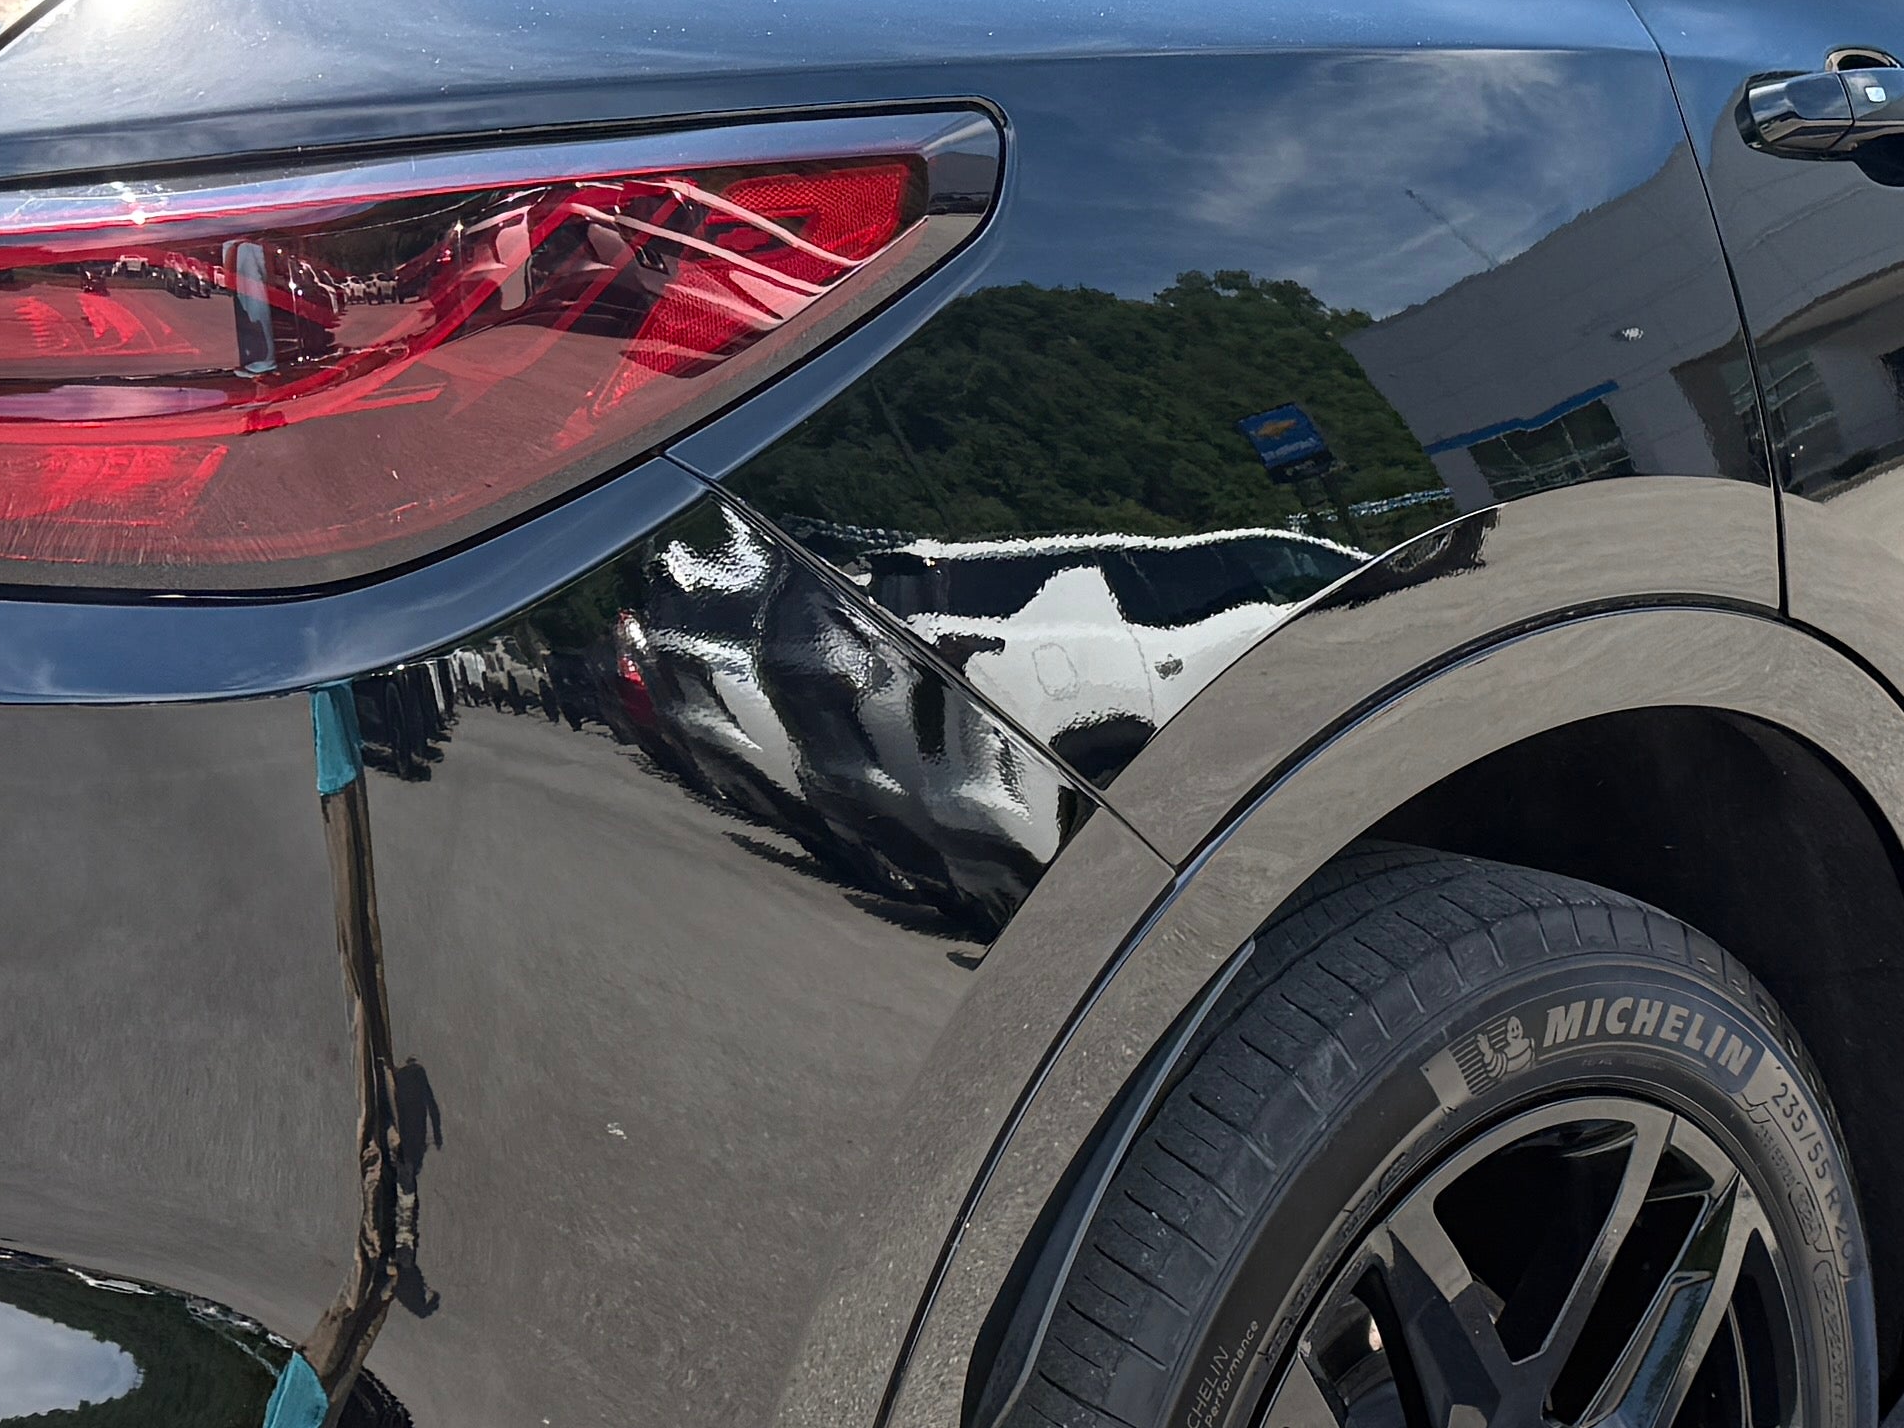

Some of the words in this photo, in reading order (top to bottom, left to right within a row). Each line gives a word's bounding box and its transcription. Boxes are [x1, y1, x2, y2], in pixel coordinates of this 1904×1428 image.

[1543, 996, 1754, 1077] MICHELIN
[1771, 1082, 1826, 1179] 235/55
[1825, 1186, 1842, 1211] R
[1205, 1320, 1258, 1428] Performance
